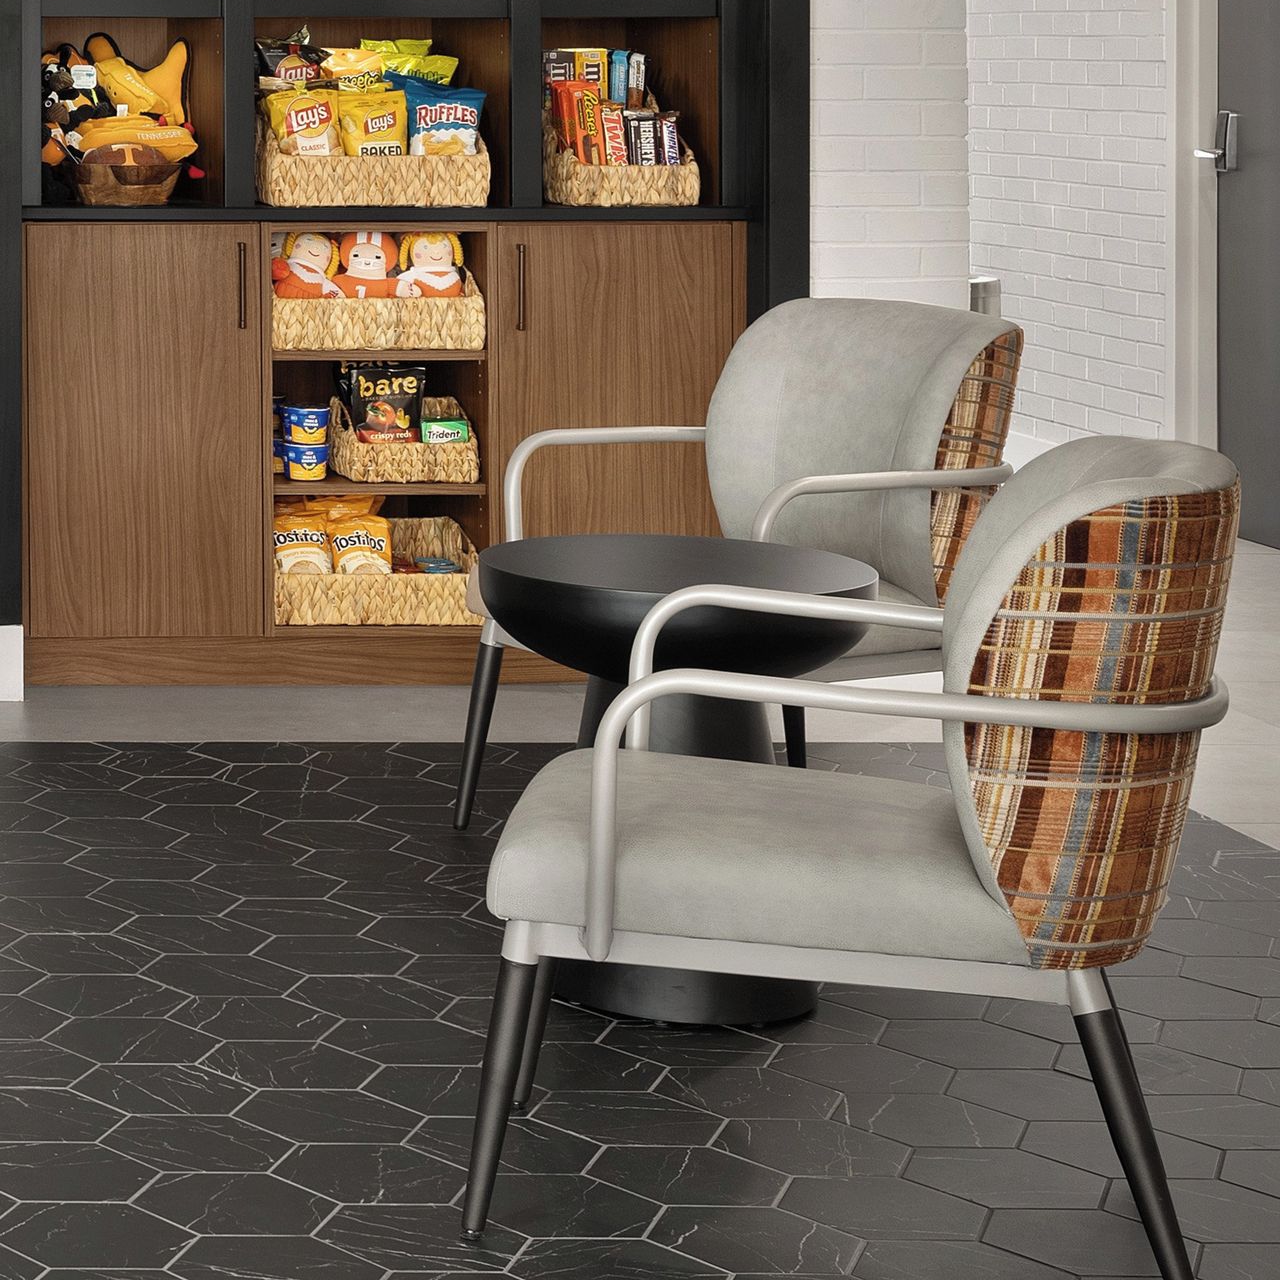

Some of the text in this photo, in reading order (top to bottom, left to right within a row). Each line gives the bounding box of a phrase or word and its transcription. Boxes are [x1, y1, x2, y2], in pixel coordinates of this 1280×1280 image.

[290, 104, 328, 132] Lay's
[367, 114, 394, 133] Lay's
[416, 104, 478, 128] RUFFLES
[582, 88, 599, 138] Reese's
[301, 143, 327, 151] CLASSIC
[639, 120, 656, 166] HERSHEY'S
[111, 144, 144, 166] T
[354, 284, 367, 299] 1
[358, 375, 418, 398] bare
[370, 430, 412, 440] crispy reds
[427, 430, 461, 440] Trident
